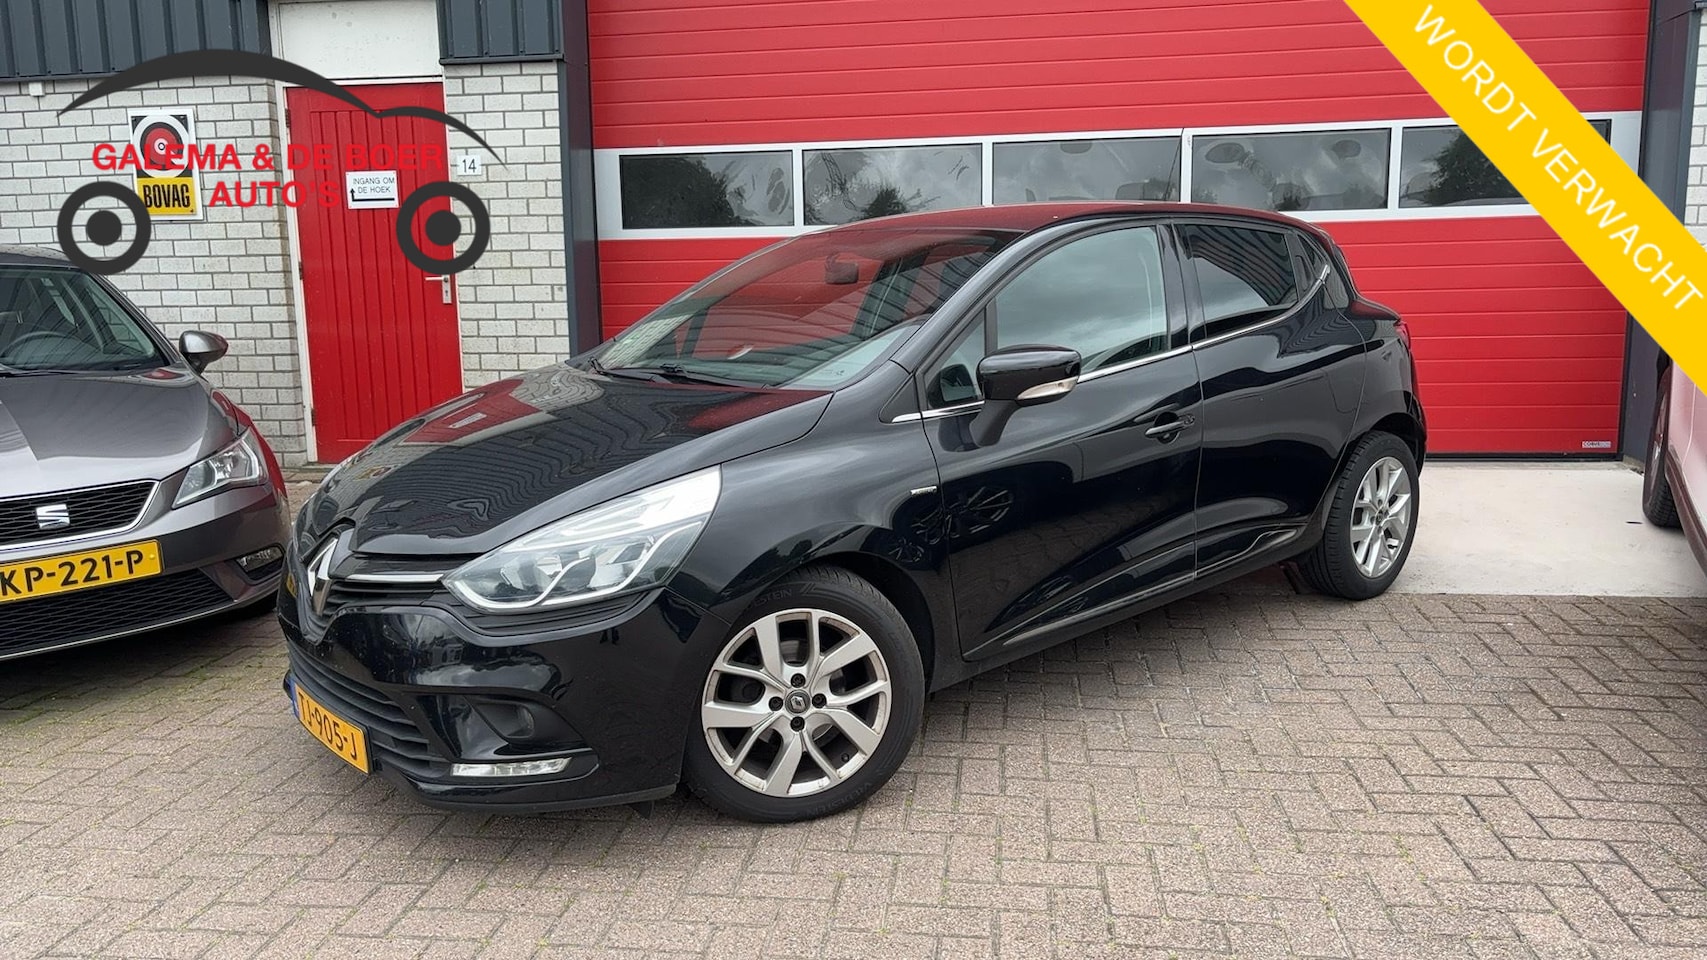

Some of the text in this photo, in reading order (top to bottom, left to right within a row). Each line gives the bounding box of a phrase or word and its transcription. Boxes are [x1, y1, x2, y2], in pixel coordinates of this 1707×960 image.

[462, 158, 477, 173] 14
[353, 176, 395, 185] INGANG OM
[357, 186, 368, 194] DE
[143, 184, 190, 208] BOVAG
[0, 550, 144, 596] KP-221-P
[298, 691, 358, 761] TJ-905-J
